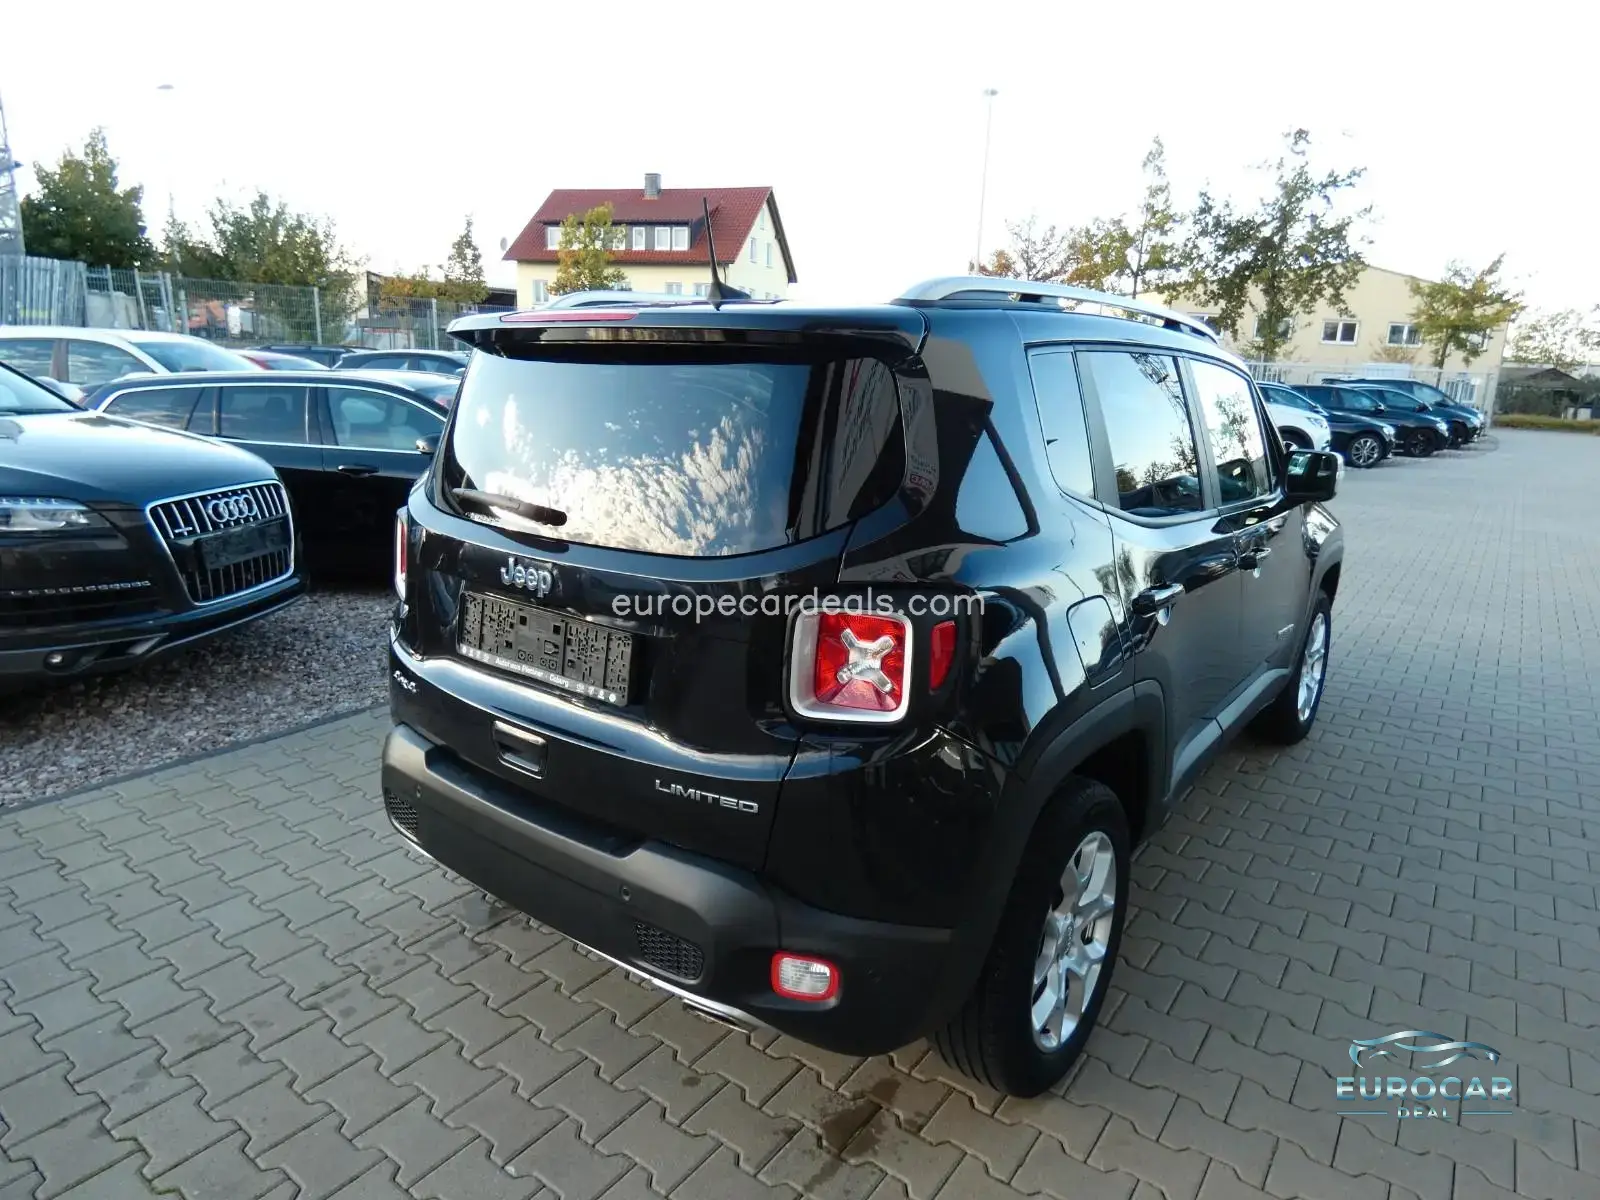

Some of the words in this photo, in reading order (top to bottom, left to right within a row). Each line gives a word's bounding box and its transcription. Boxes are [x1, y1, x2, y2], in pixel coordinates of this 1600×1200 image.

[500, 557, 552, 598] Jeep
[549, 673, 569, 688] Coburg
[655, 779, 759, 814] LIMITED
